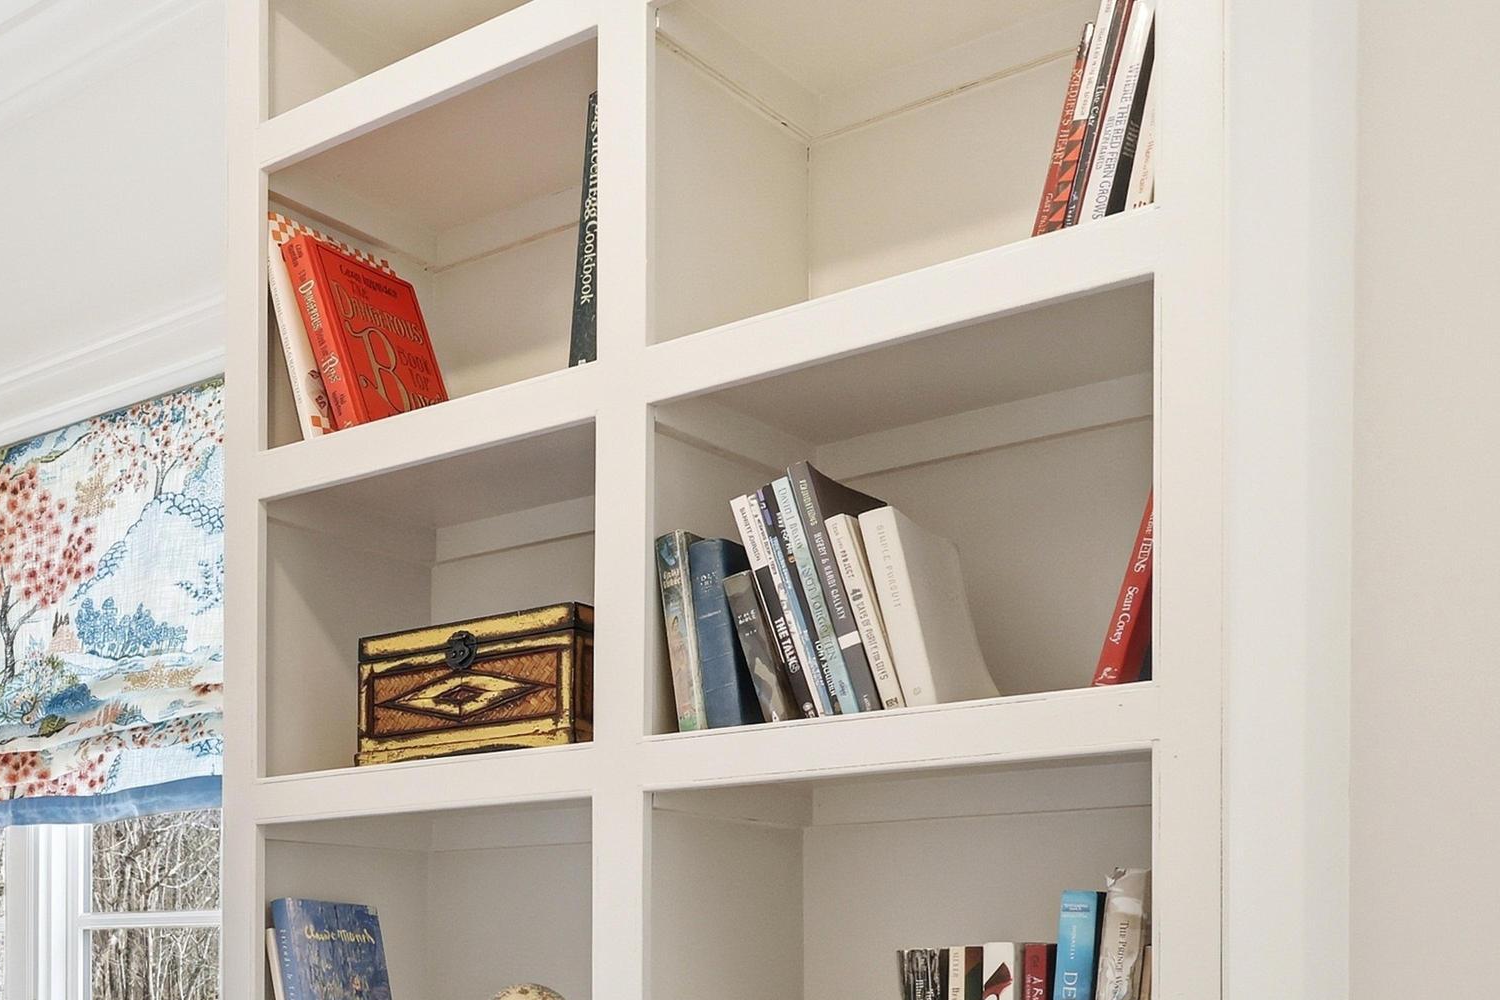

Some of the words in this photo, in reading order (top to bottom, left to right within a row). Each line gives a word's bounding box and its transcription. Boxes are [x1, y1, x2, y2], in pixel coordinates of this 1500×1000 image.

[1116, 103, 1130, 126] THE
[1052, 127, 1069, 167] HEART
[1111, 127, 1124, 150] RED
[1102, 151, 1119, 181] FERN
[1091, 181, 1113, 220] GROWS
[580, 219, 599, 305] Cookbook
[849, 586, 864, 602] 40
[1122, 585, 1139, 613] Sean
[774, 617, 790, 640] THE
[810, 596, 838, 660] FORGOTTEN
[1109, 612, 1131, 645] Covey
[781, 639, 800, 673] TALKS
[304, 924, 336, 943] Claude
